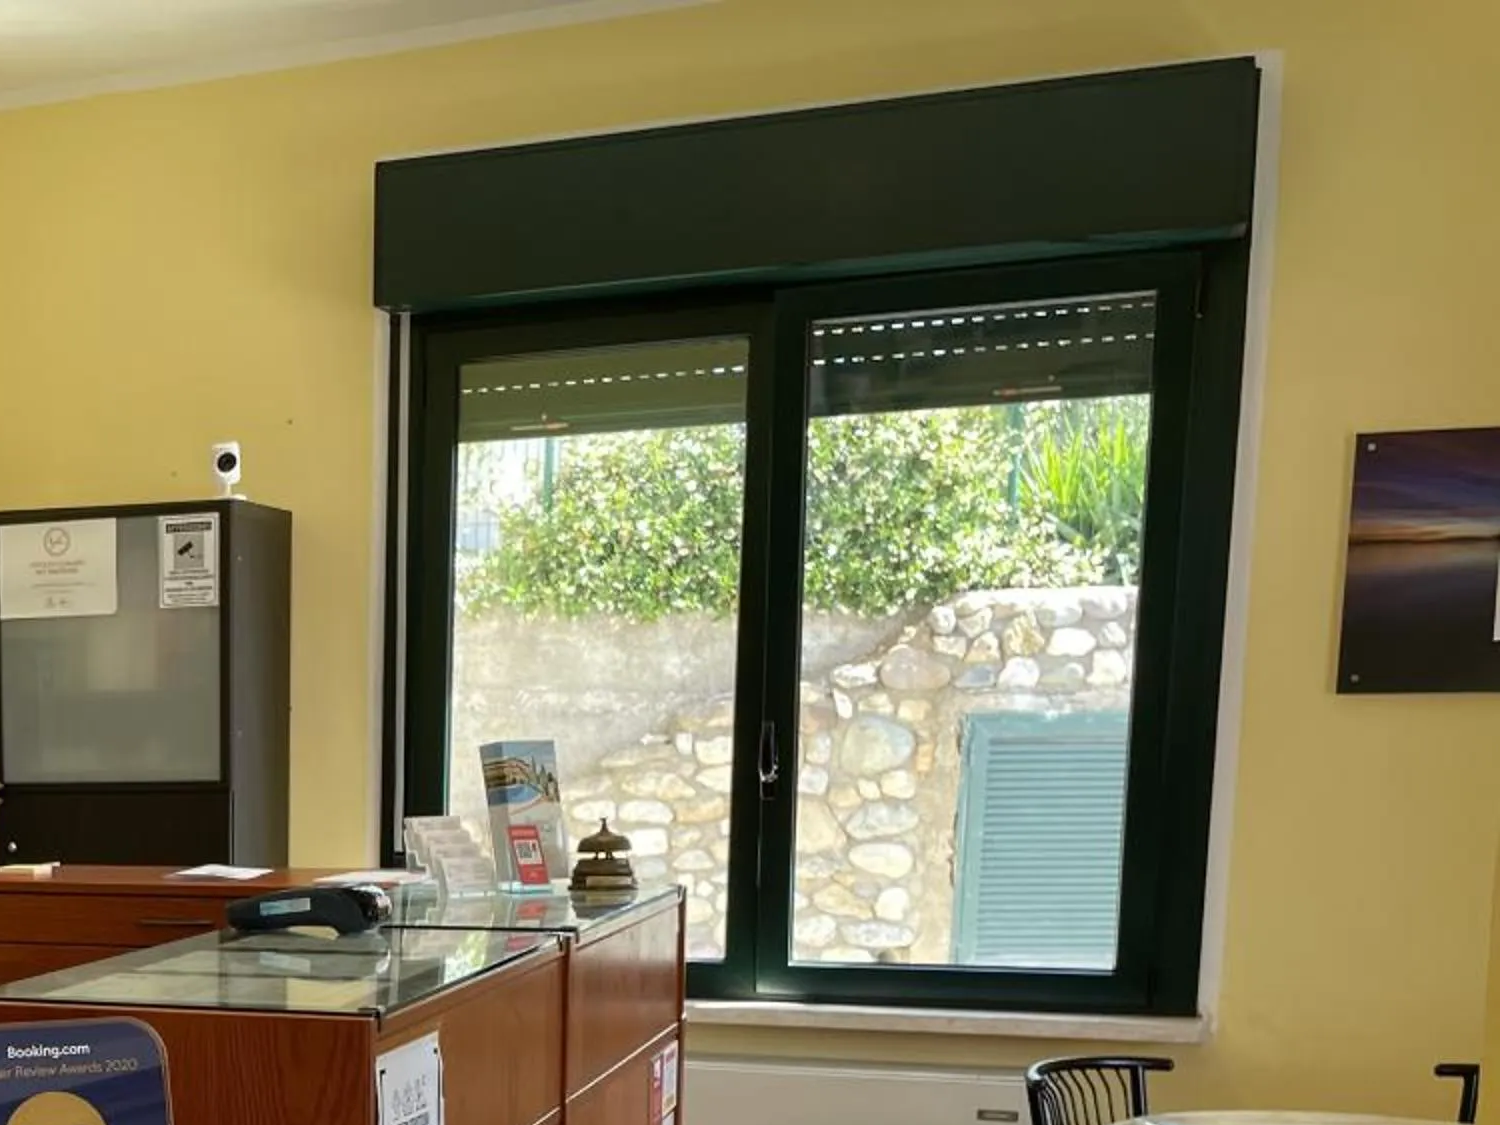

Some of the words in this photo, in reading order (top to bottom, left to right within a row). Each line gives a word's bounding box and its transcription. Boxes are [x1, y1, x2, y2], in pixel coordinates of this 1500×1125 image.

[6, 1043, 91, 1060] Booking.com
[15, 1063, 56, 1078] Review
[59, 1061, 103, 1076] Awards
[105, 1058, 138, 1073] 2020
